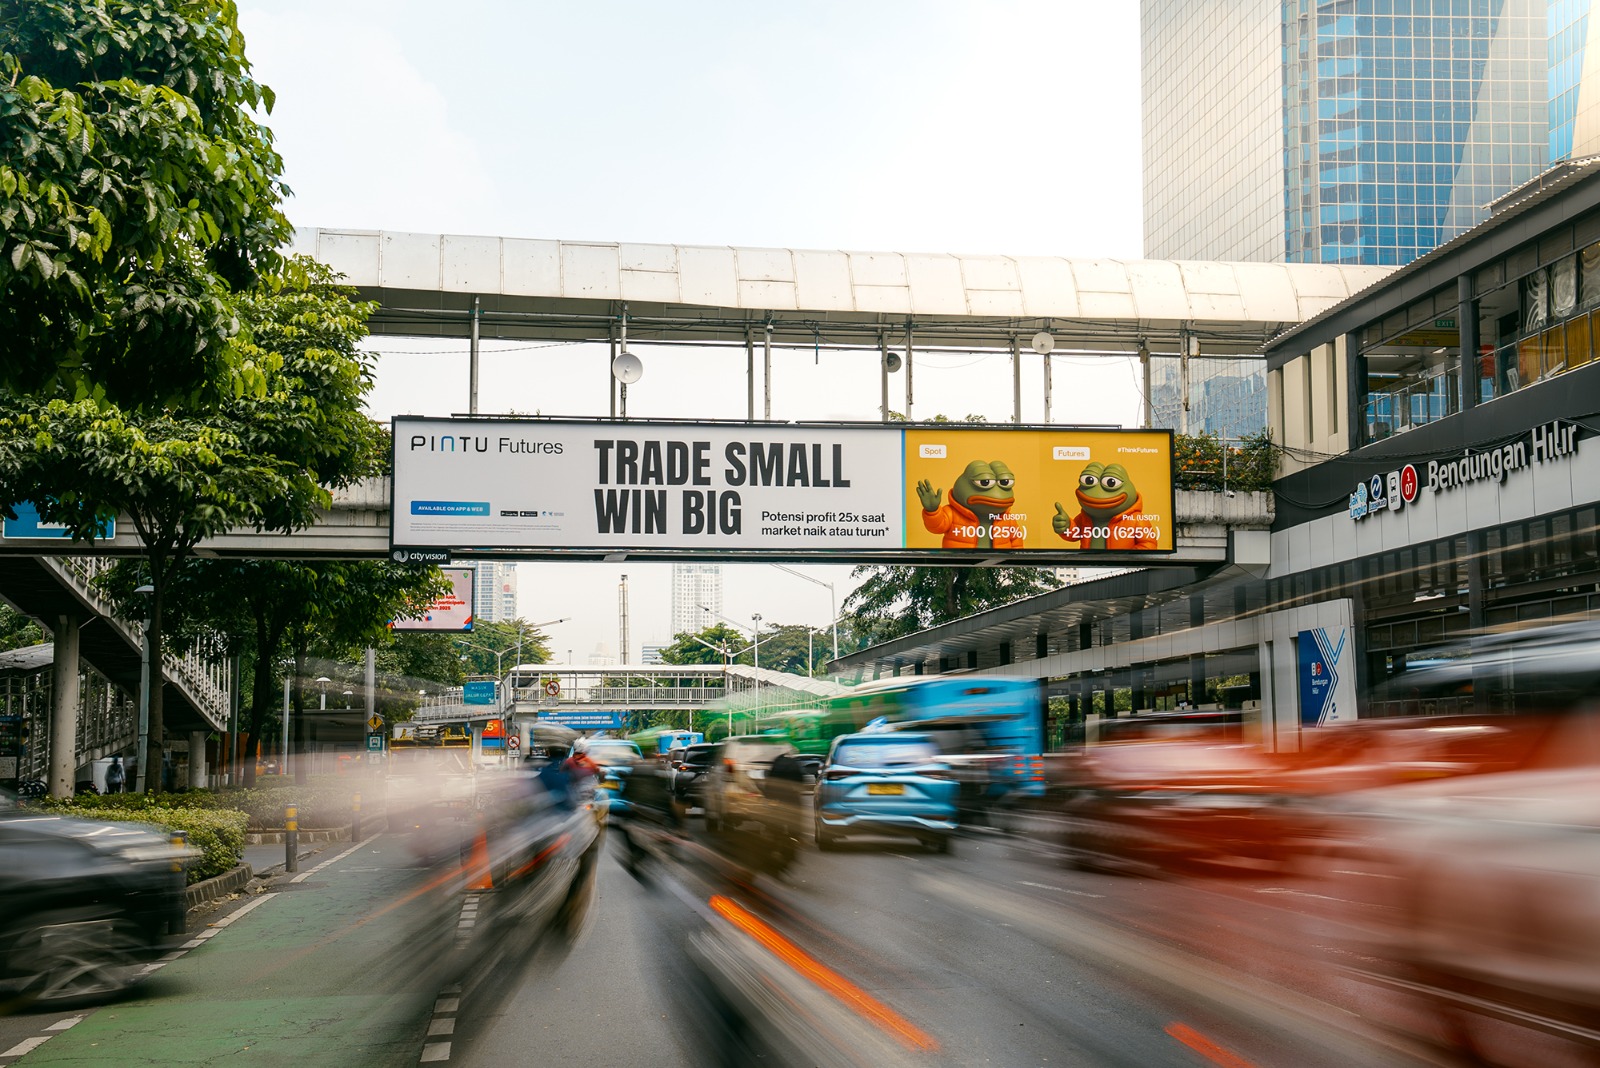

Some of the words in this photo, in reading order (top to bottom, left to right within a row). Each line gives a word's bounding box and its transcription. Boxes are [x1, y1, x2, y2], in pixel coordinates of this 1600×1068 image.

[410, 436, 488, 452] PINTU
[499, 437, 564, 454] Futures
[925, 447, 942, 458] Spot
[1058, 450, 1085, 458] Futures
[594, 440, 711, 486] TRADE
[725, 441, 850, 488] SMALL
[1428, 442, 1526, 492] Bendungan
[1406, 472, 1410, 482] 1
[1406, 483, 1413, 496] 07
[594, 489, 667, 535] WIN
[682, 490, 742, 536] BIG
[762, 511, 804, 522] Potensi
[806, 511, 836, 525] profit
[838, 512, 860, 523] 25x
[863, 512, 886, 523] saat
[988, 512, 1001, 520] PnL
[1003, 512, 1028, 522] (USDT)
[1137, 514, 1160, 522] (USDT)
[762, 524, 800, 537] market
[804, 525, 826, 537] naik
[829, 527, 852, 538] atau
[952, 526, 986, 538] +100
[988, 526, 1028, 540] (25%)
[1063, 527, 1111, 540] +2.500
[1114, 527, 1161, 541] (625%)
